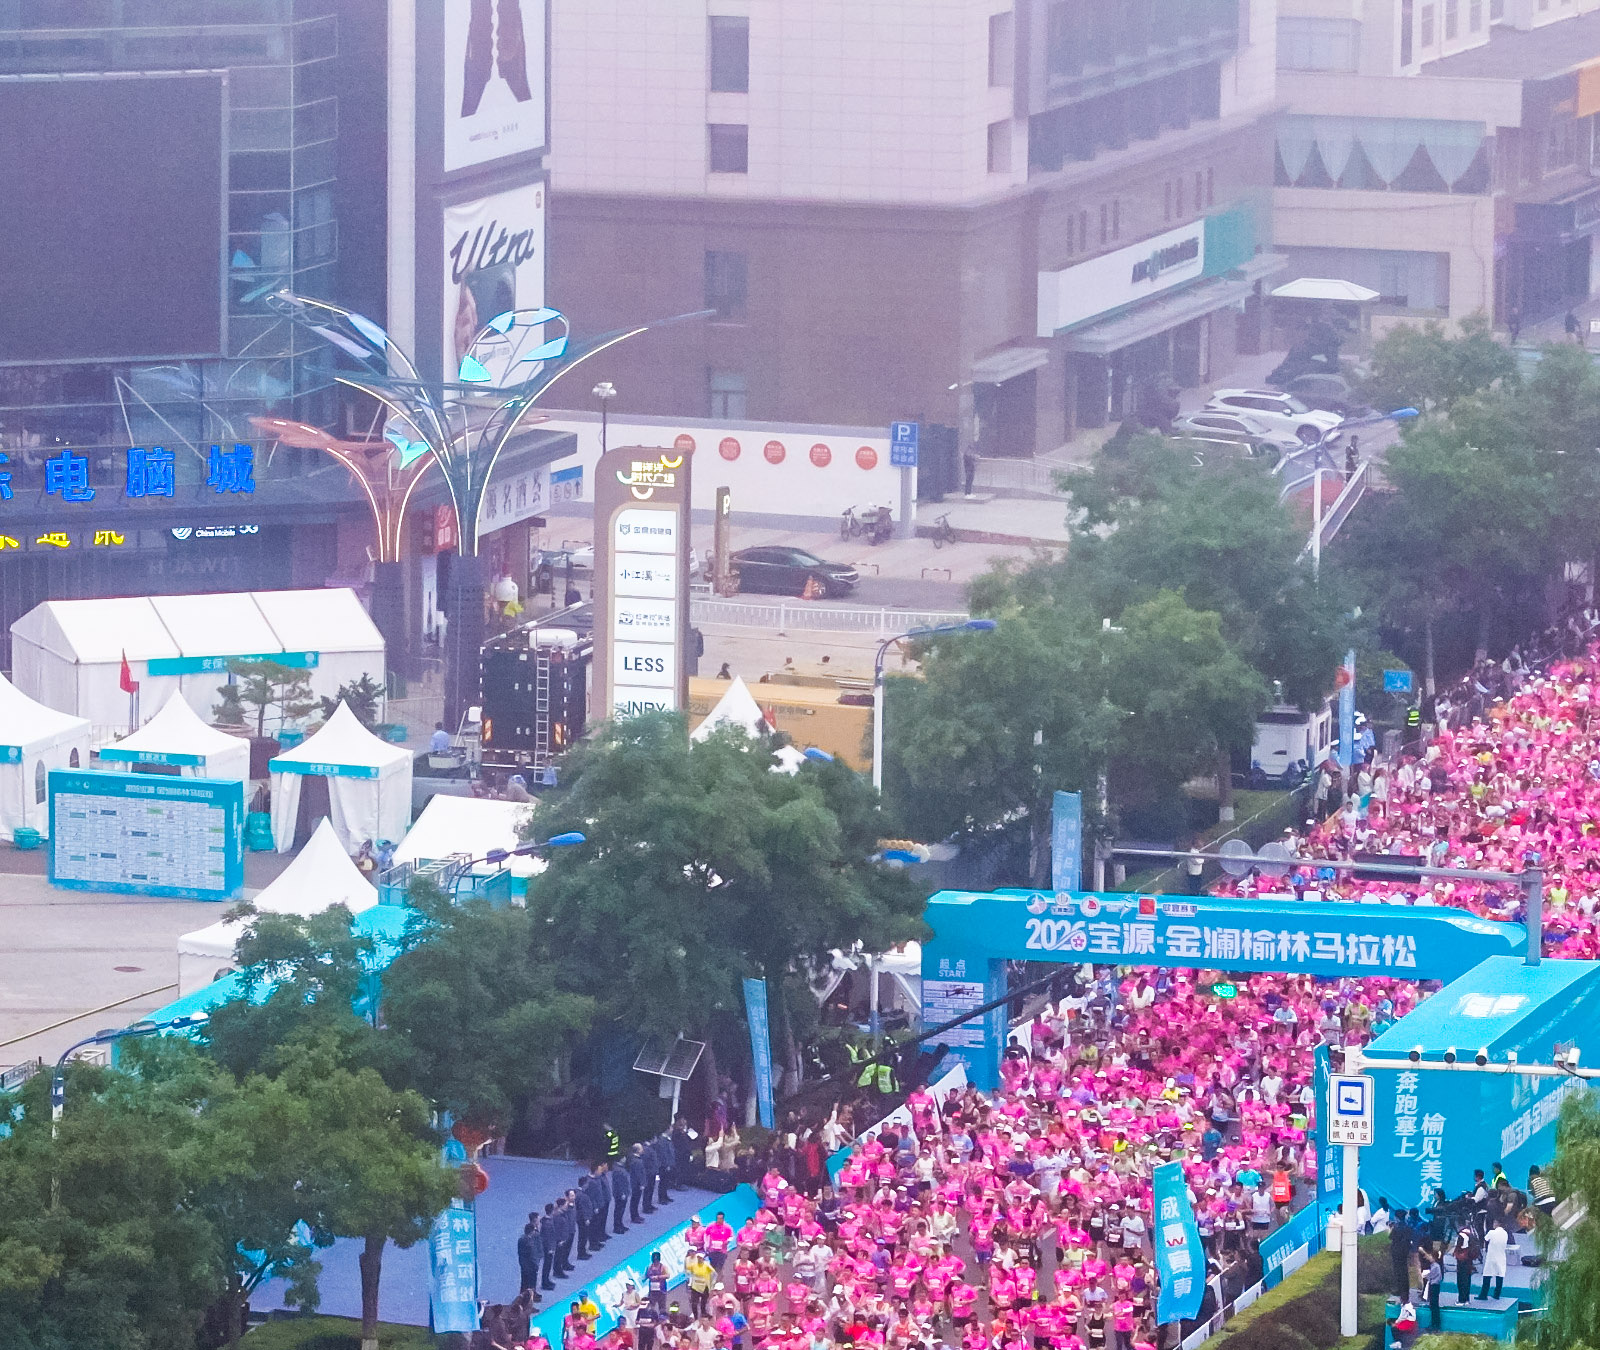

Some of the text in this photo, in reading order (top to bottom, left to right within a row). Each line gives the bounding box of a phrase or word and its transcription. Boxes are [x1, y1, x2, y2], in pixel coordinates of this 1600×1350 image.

[449, 219, 535, 286] Ultra
[624, 656, 665, 673] LESS
[938, 969, 966, 978] START
[1332, 1119, 1369, 1129] 违法信息
[1393, 1071, 1420, 1158] 奔跑塞上
[1413, 1112, 1447, 1207] 榆见美好
